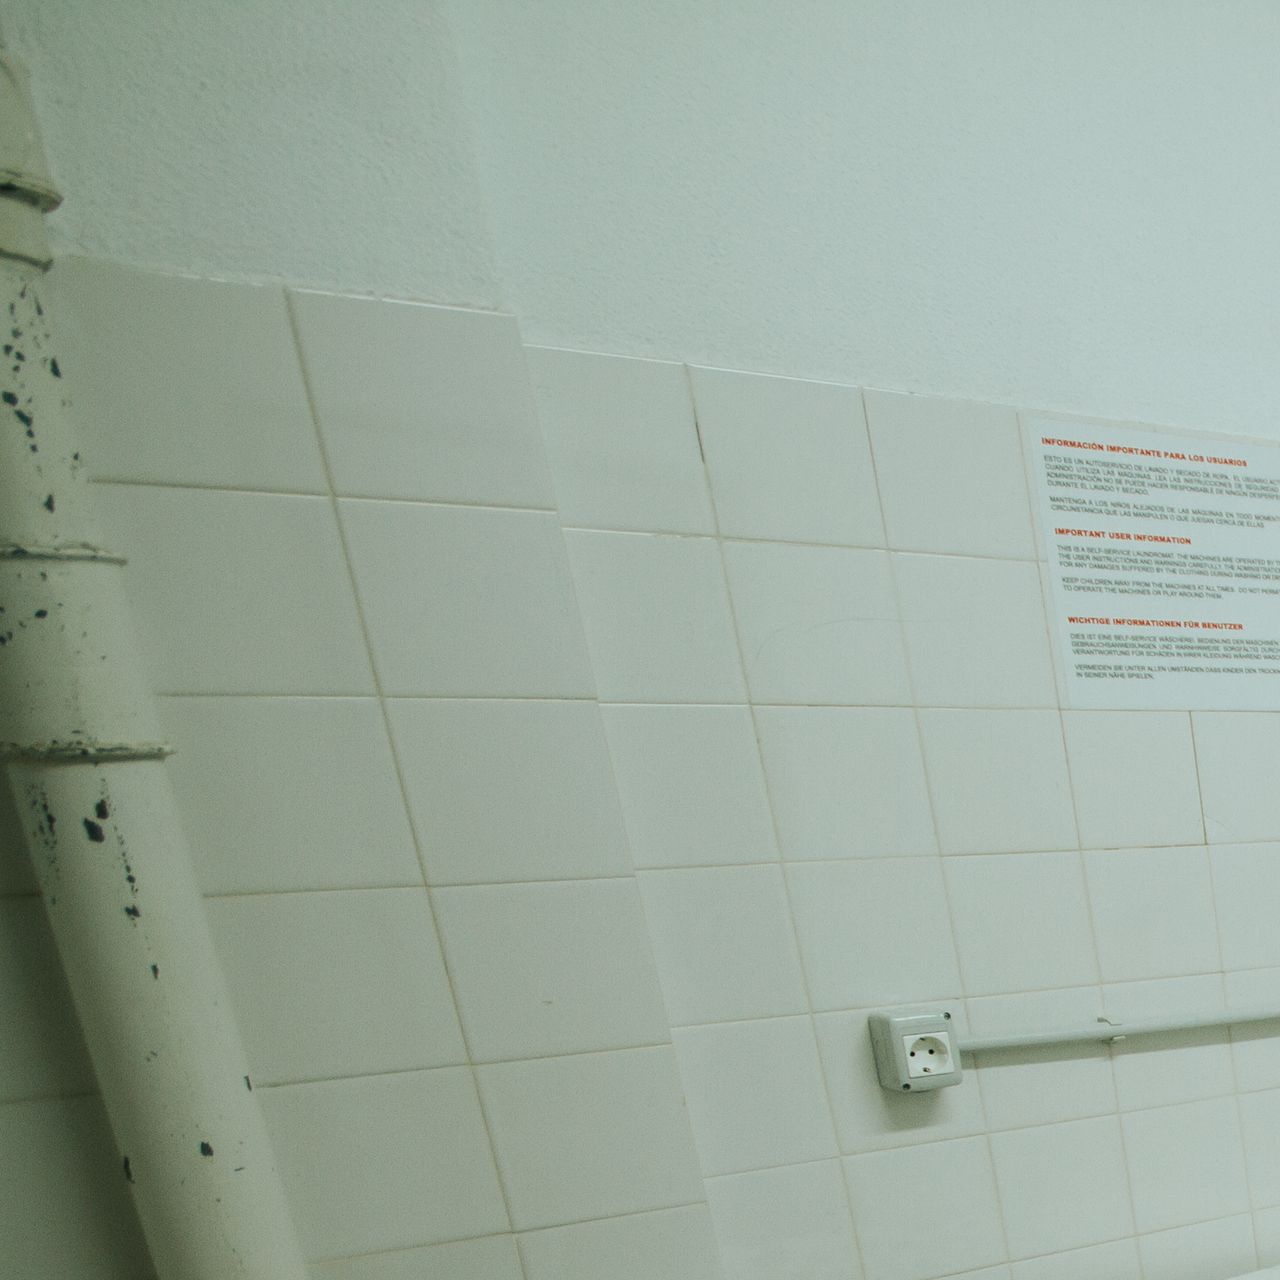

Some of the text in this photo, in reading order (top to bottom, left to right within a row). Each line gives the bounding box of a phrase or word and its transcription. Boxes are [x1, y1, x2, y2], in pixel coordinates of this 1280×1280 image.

[1041, 438, 1248, 467] INFORMACIÓN IMPORTANTE PARA LOS USUARIOS
[1055, 528, 1191, 544] IMPORTANT USER INFORMATION
[1068, 617, 1111, 625] WICHTIGE
[1112, 619, 1182, 627] INFORMATIONEN
[1201, 622, 1243, 630] BENUTZER
